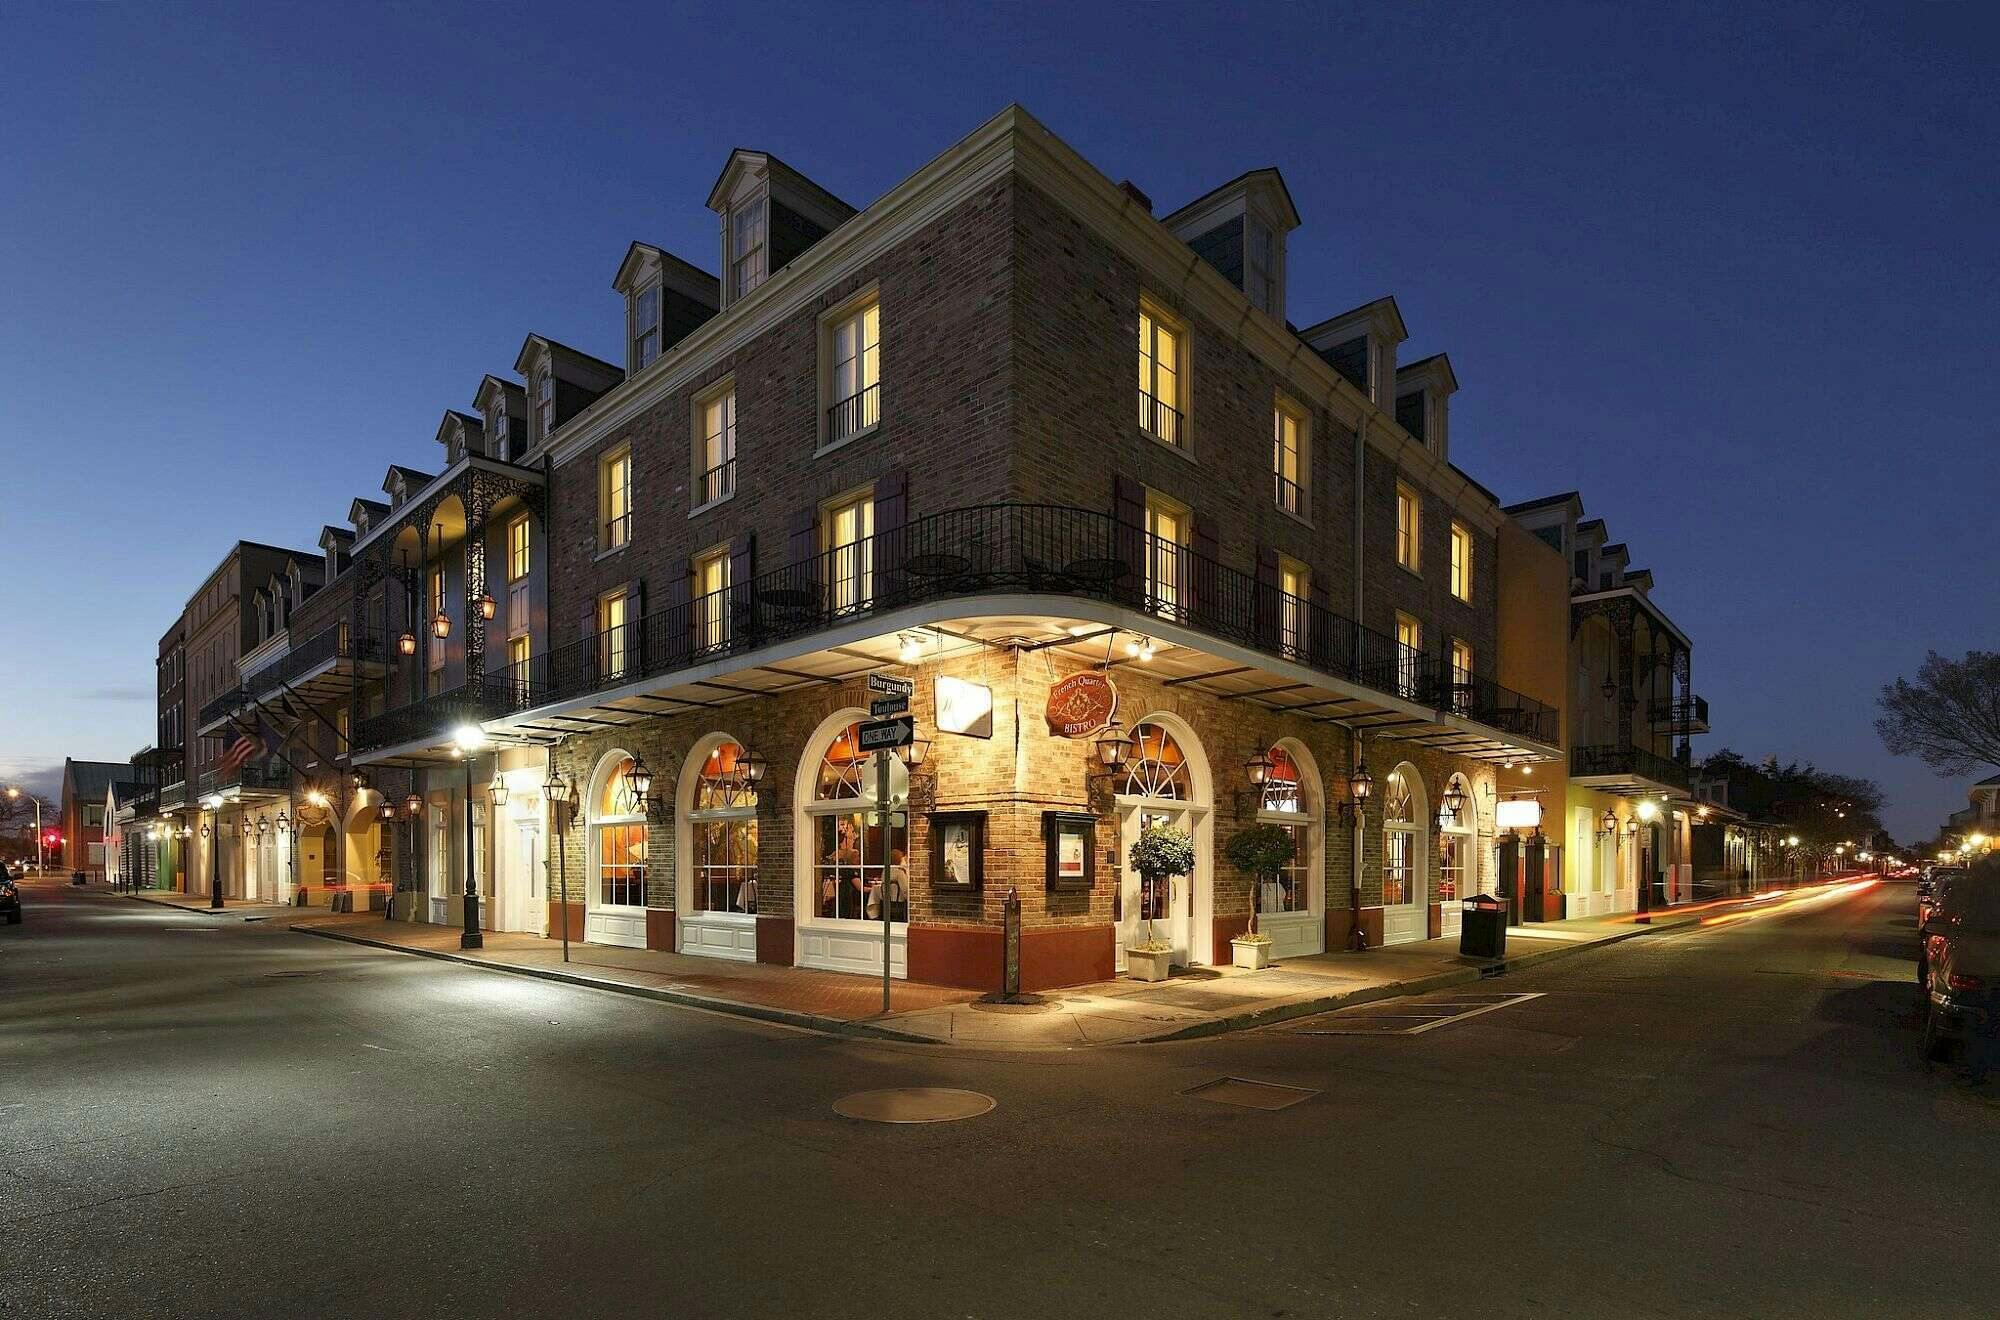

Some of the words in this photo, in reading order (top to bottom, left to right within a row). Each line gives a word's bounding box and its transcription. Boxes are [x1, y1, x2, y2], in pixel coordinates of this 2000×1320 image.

[870, 676, 912, 694] Burgundy
[1053, 680, 1077, 699] French
[1078, 675, 1105, 689] Quarter
[873, 702, 906, 714] Toulouse
[863, 730, 880, 743] ONE
[880, 726, 897, 740] WAY
[1064, 719, 1096, 733] BISTRO
